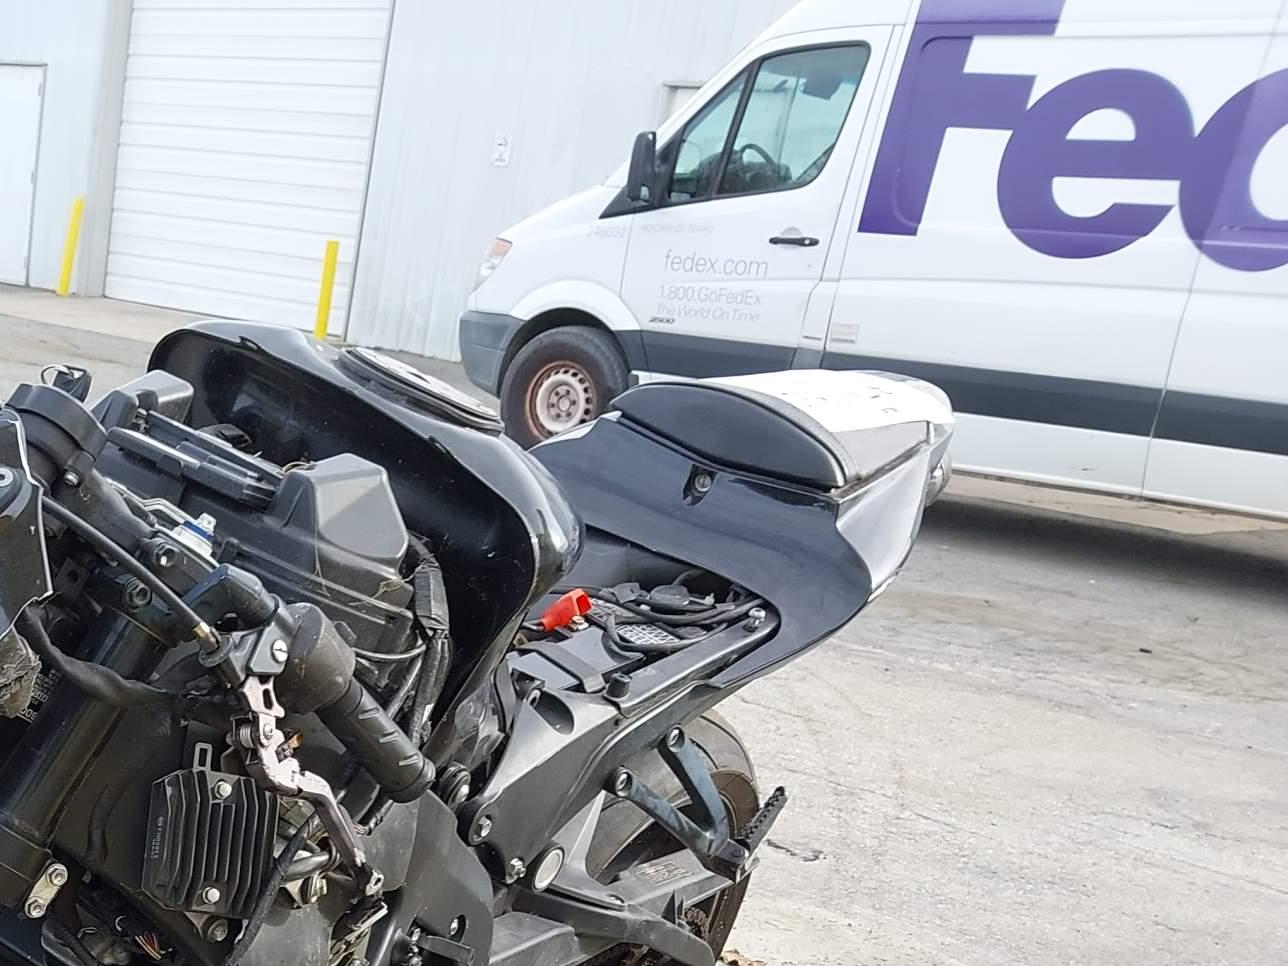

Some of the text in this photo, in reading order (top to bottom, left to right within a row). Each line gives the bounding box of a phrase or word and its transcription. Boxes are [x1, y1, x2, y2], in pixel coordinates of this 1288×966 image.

[664, 249, 768, 276] fedex.com
[660, 284, 761, 306] 1.800.GoFedEx
[676, 304, 712, 320] World
[712, 307, 731, 321] On
[731, 308, 760, 322] Time
